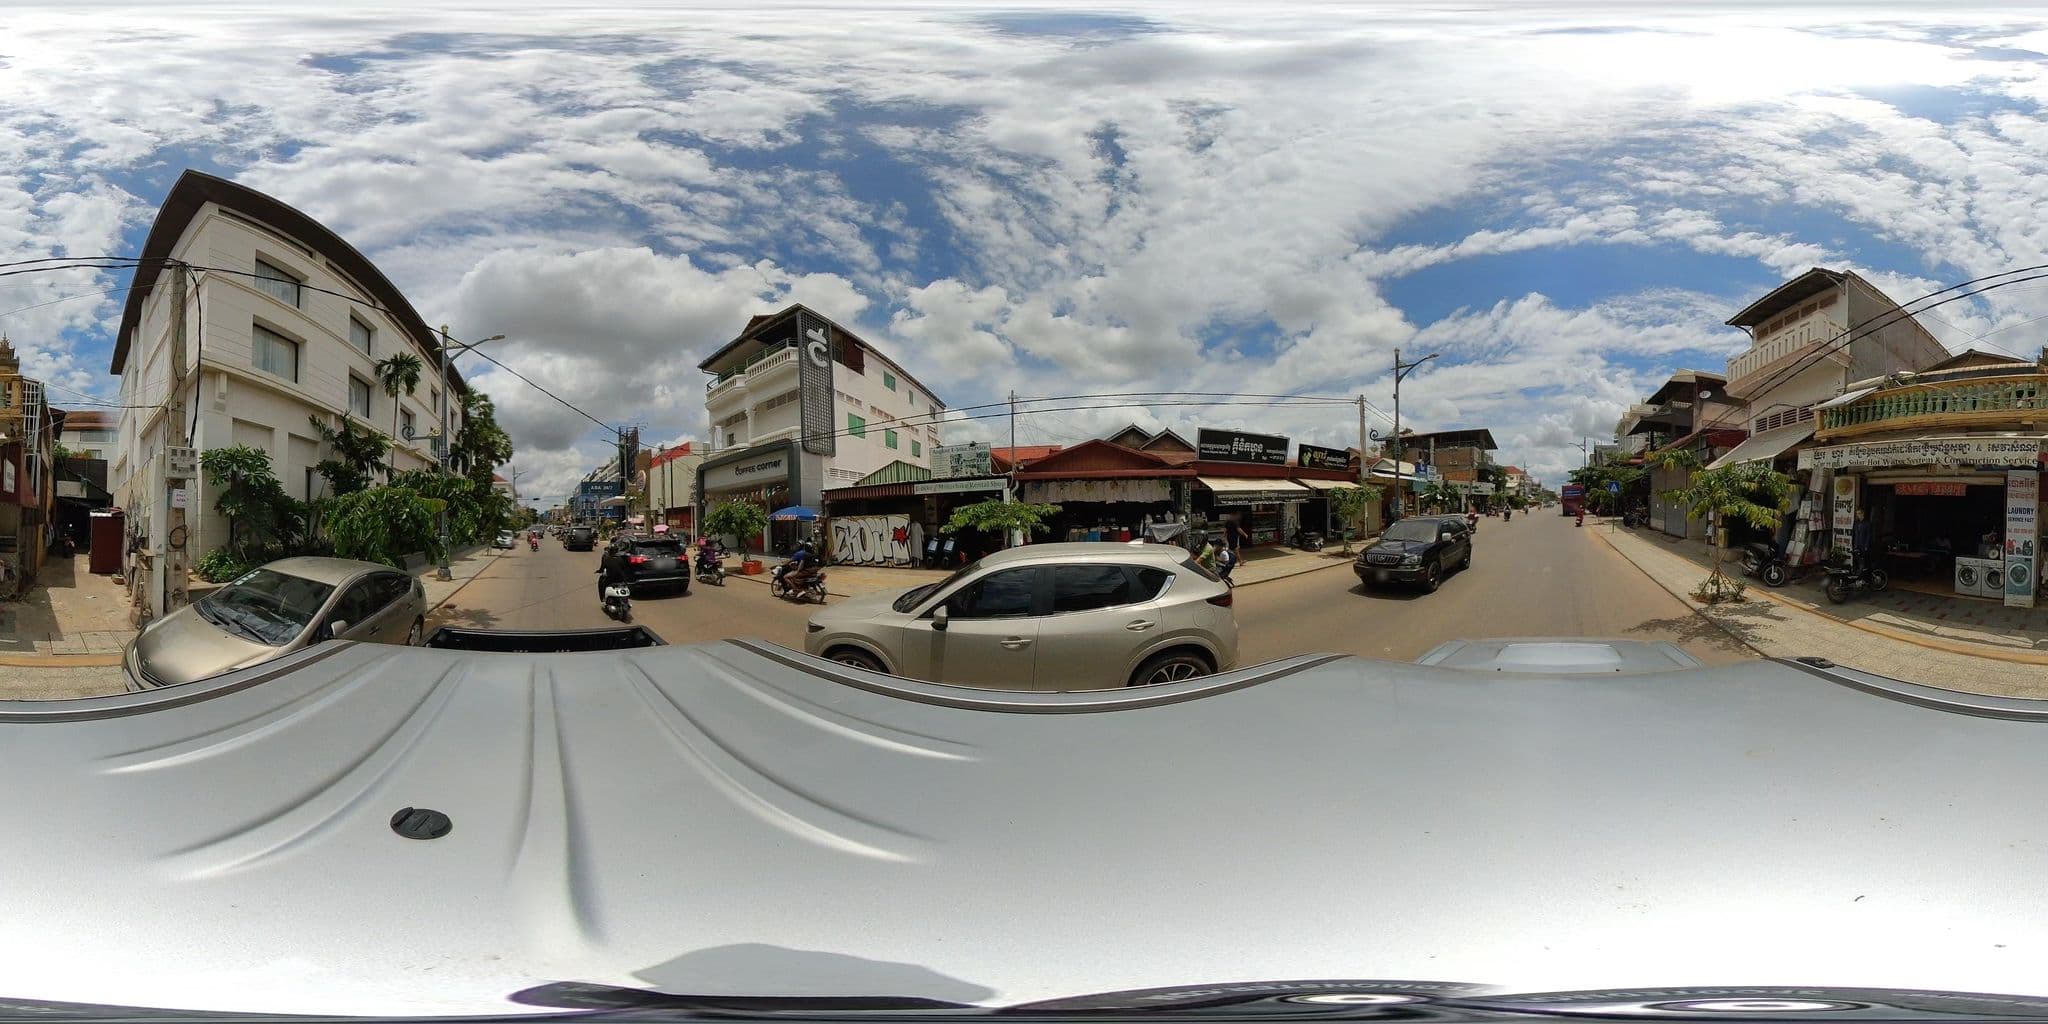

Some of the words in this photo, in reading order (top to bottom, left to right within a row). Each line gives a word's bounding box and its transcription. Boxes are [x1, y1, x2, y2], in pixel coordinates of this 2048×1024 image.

[1848, 458, 1865, 466] Solar
[1867, 458, 1880, 466] Hot
[1944, 456, 2000, 466] Construction
[2003, 455, 2038, 465] Service
[735, 465, 756, 476] COFFEE
[756, 459, 782, 471] corner
[2007, 506, 2034, 515] LAUNDRY
